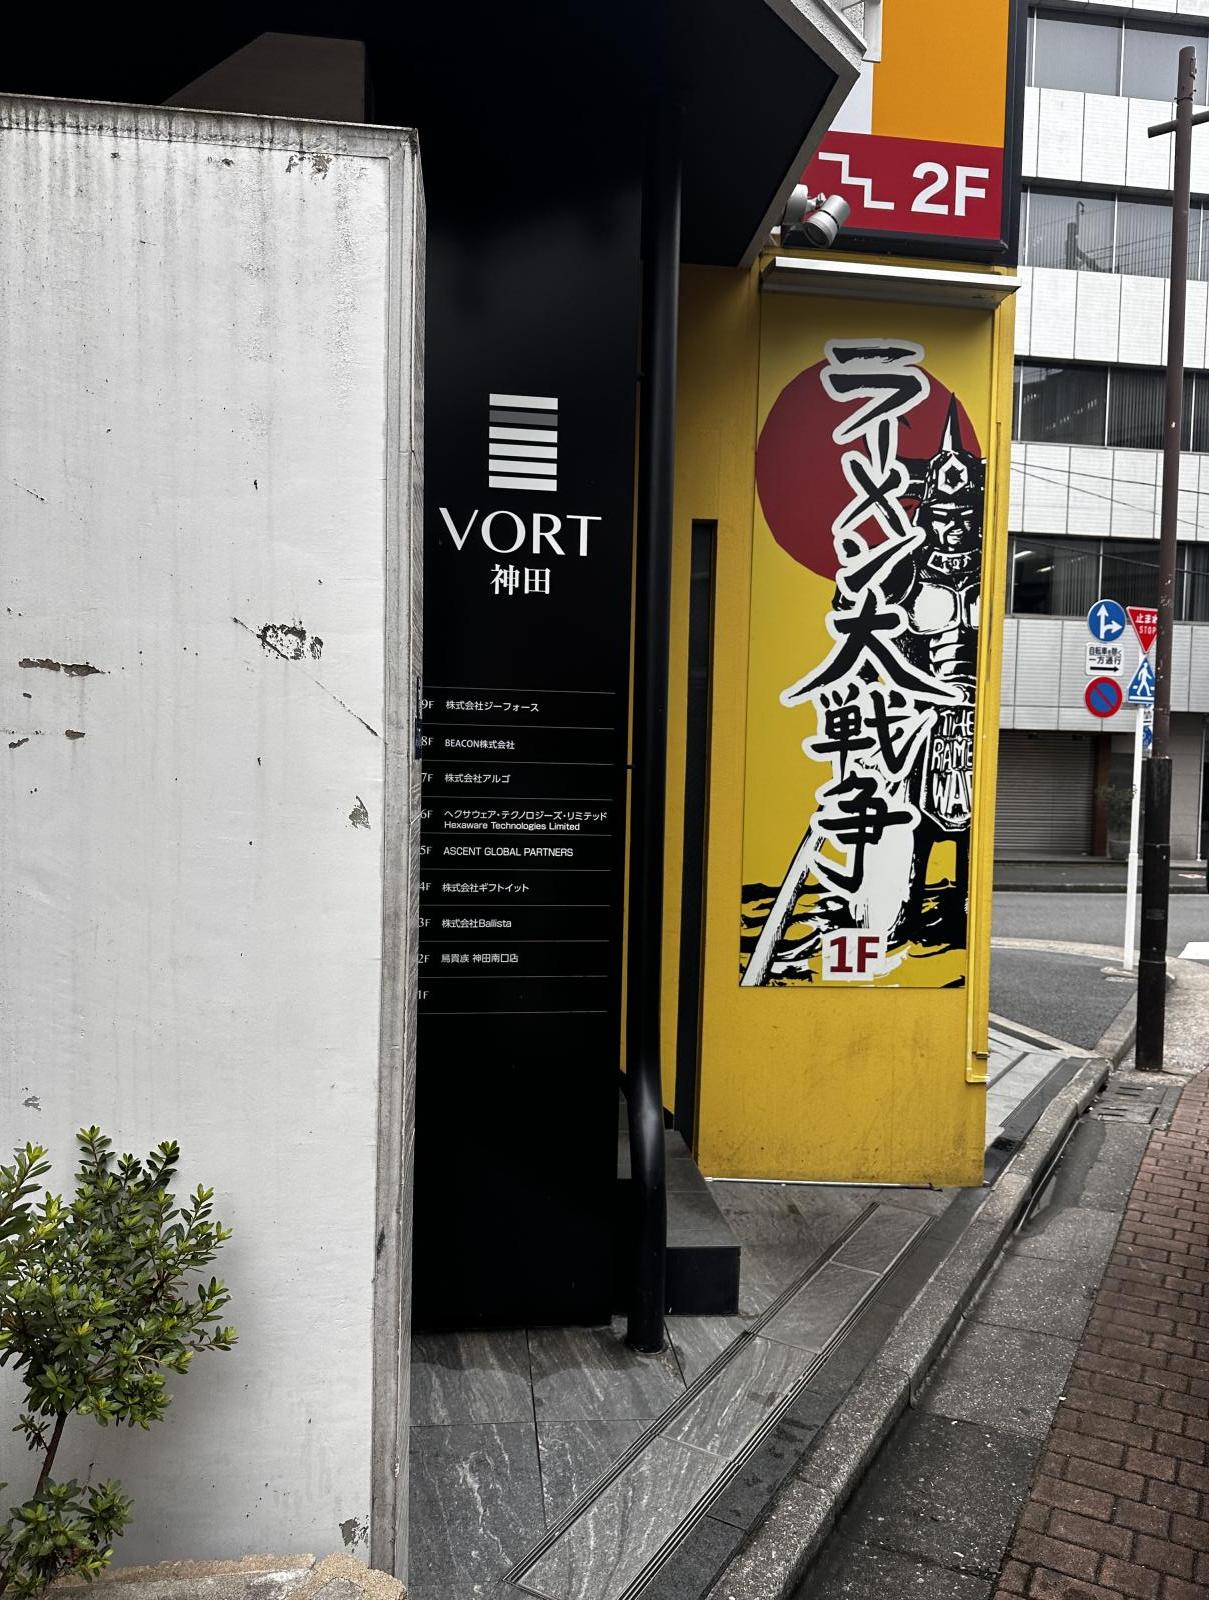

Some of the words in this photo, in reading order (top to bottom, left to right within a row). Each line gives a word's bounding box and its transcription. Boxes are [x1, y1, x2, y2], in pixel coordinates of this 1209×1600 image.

[911, 161, 990, 217] 2F
[438, 507, 602, 557] VORT
[490, 563, 551, 596] 神田
[783, 341, 962, 895] ラーメン大戦争
[1139, 625, 1157, 635] STOP
[1088, 655, 1122, 665] 一方通行
[421, 699, 436, 709] 9F
[445, 700, 540, 712] 株式会社ジーフォース
[940, 710, 975, 736] THE
[421, 735, 435, 746] 8F
[444, 738, 516, 750] BEACON株式会社
[931, 738, 974, 771] RAME
[421, 772, 434, 783] 7F
[444, 773, 511, 784] 株式会社アルゴ
[420, 808, 434, 819] 6F
[444, 821, 489, 830] Hexaware
[490, 821, 547, 831] Technologies
[549, 822, 581, 831] Limited
[419, 845, 433, 855] 5F
[443, 847, 482, 856] ASCENT
[484, 847, 522, 856] GLOBAL
[523, 848, 574, 857] PARTNERS
[419, 882, 432, 891] 4F
[442, 882, 530, 893] 株式会社ギフトイット
[418, 917, 432, 928] 3F
[441, 918, 512, 929] 株式会社Ballista
[418, 954, 431, 964] 2F
[472, 953, 519, 963] 神田南口店
[830, 936, 880, 973] 1F
[418, 990, 430, 1000] 1F
